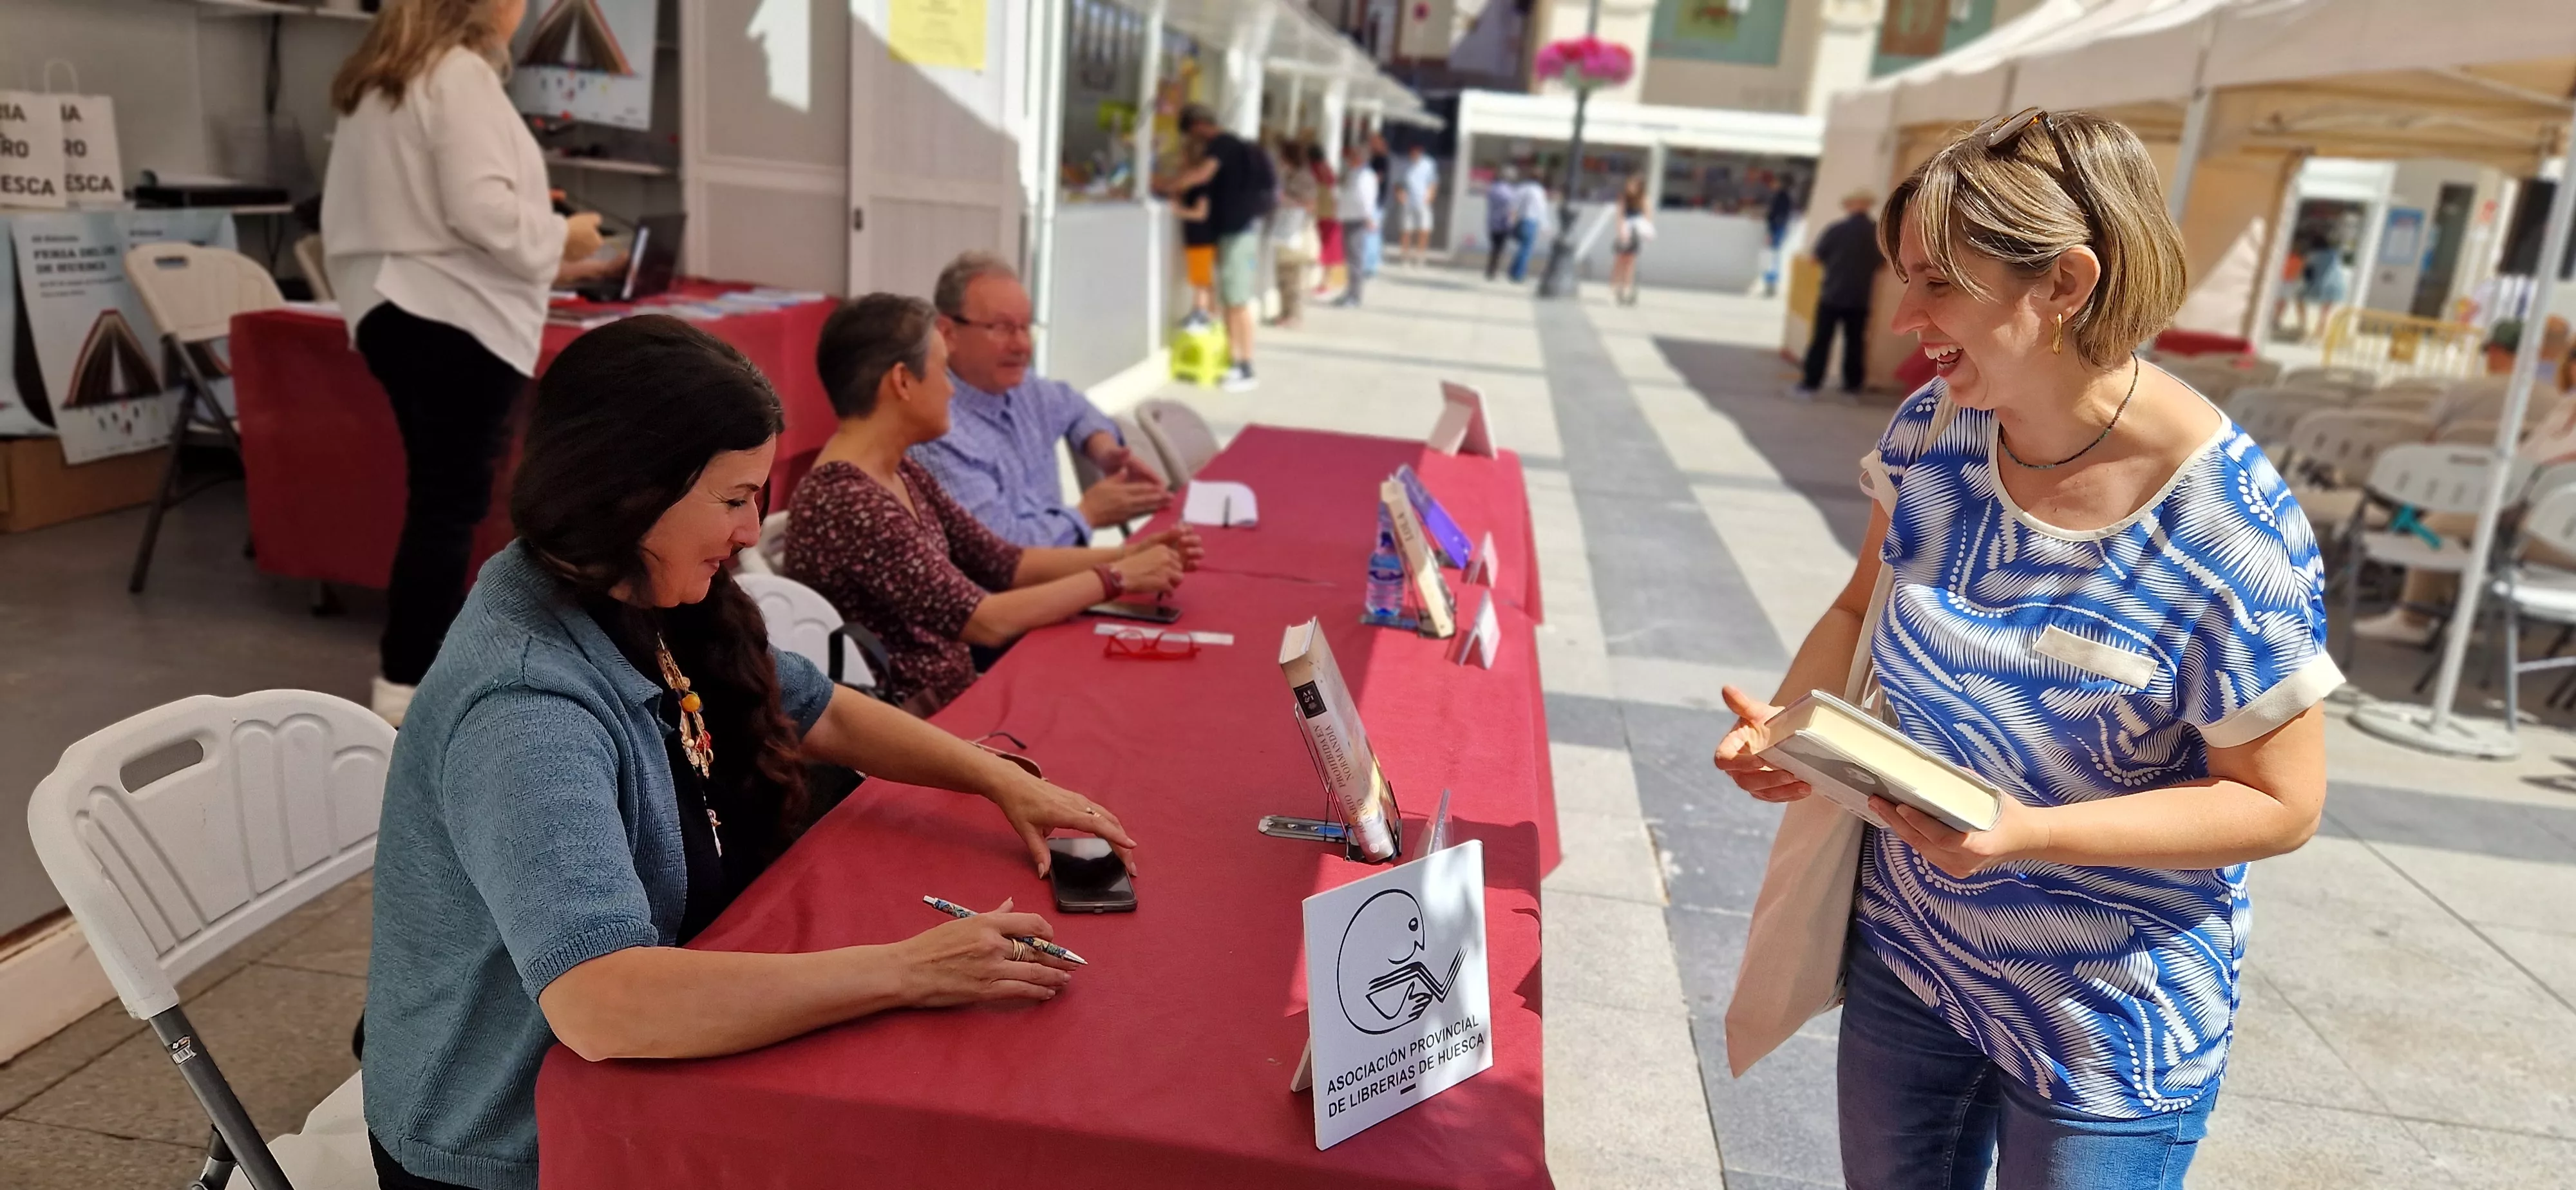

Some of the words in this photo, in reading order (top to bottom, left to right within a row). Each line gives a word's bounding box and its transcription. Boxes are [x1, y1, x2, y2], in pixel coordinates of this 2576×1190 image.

[0, 104, 26, 122] IA
[1320, 739, 1346, 788] PROHIBIDA
[1344, 795, 1367, 833] ROSARIO
[1356, 798, 1372, 824] RARO
[1327, 1046, 1406, 1095] ASOCIACIÓN
[1410, 1014, 1479, 1057] PROVINCIAL
[1329, 1097, 1346, 1119] DE
[1350, 1064, 1416, 1108] LIBRERIAS
[1419, 1055, 1435, 1075] DE
[1438, 1032, 1485, 1066] HUESCA
